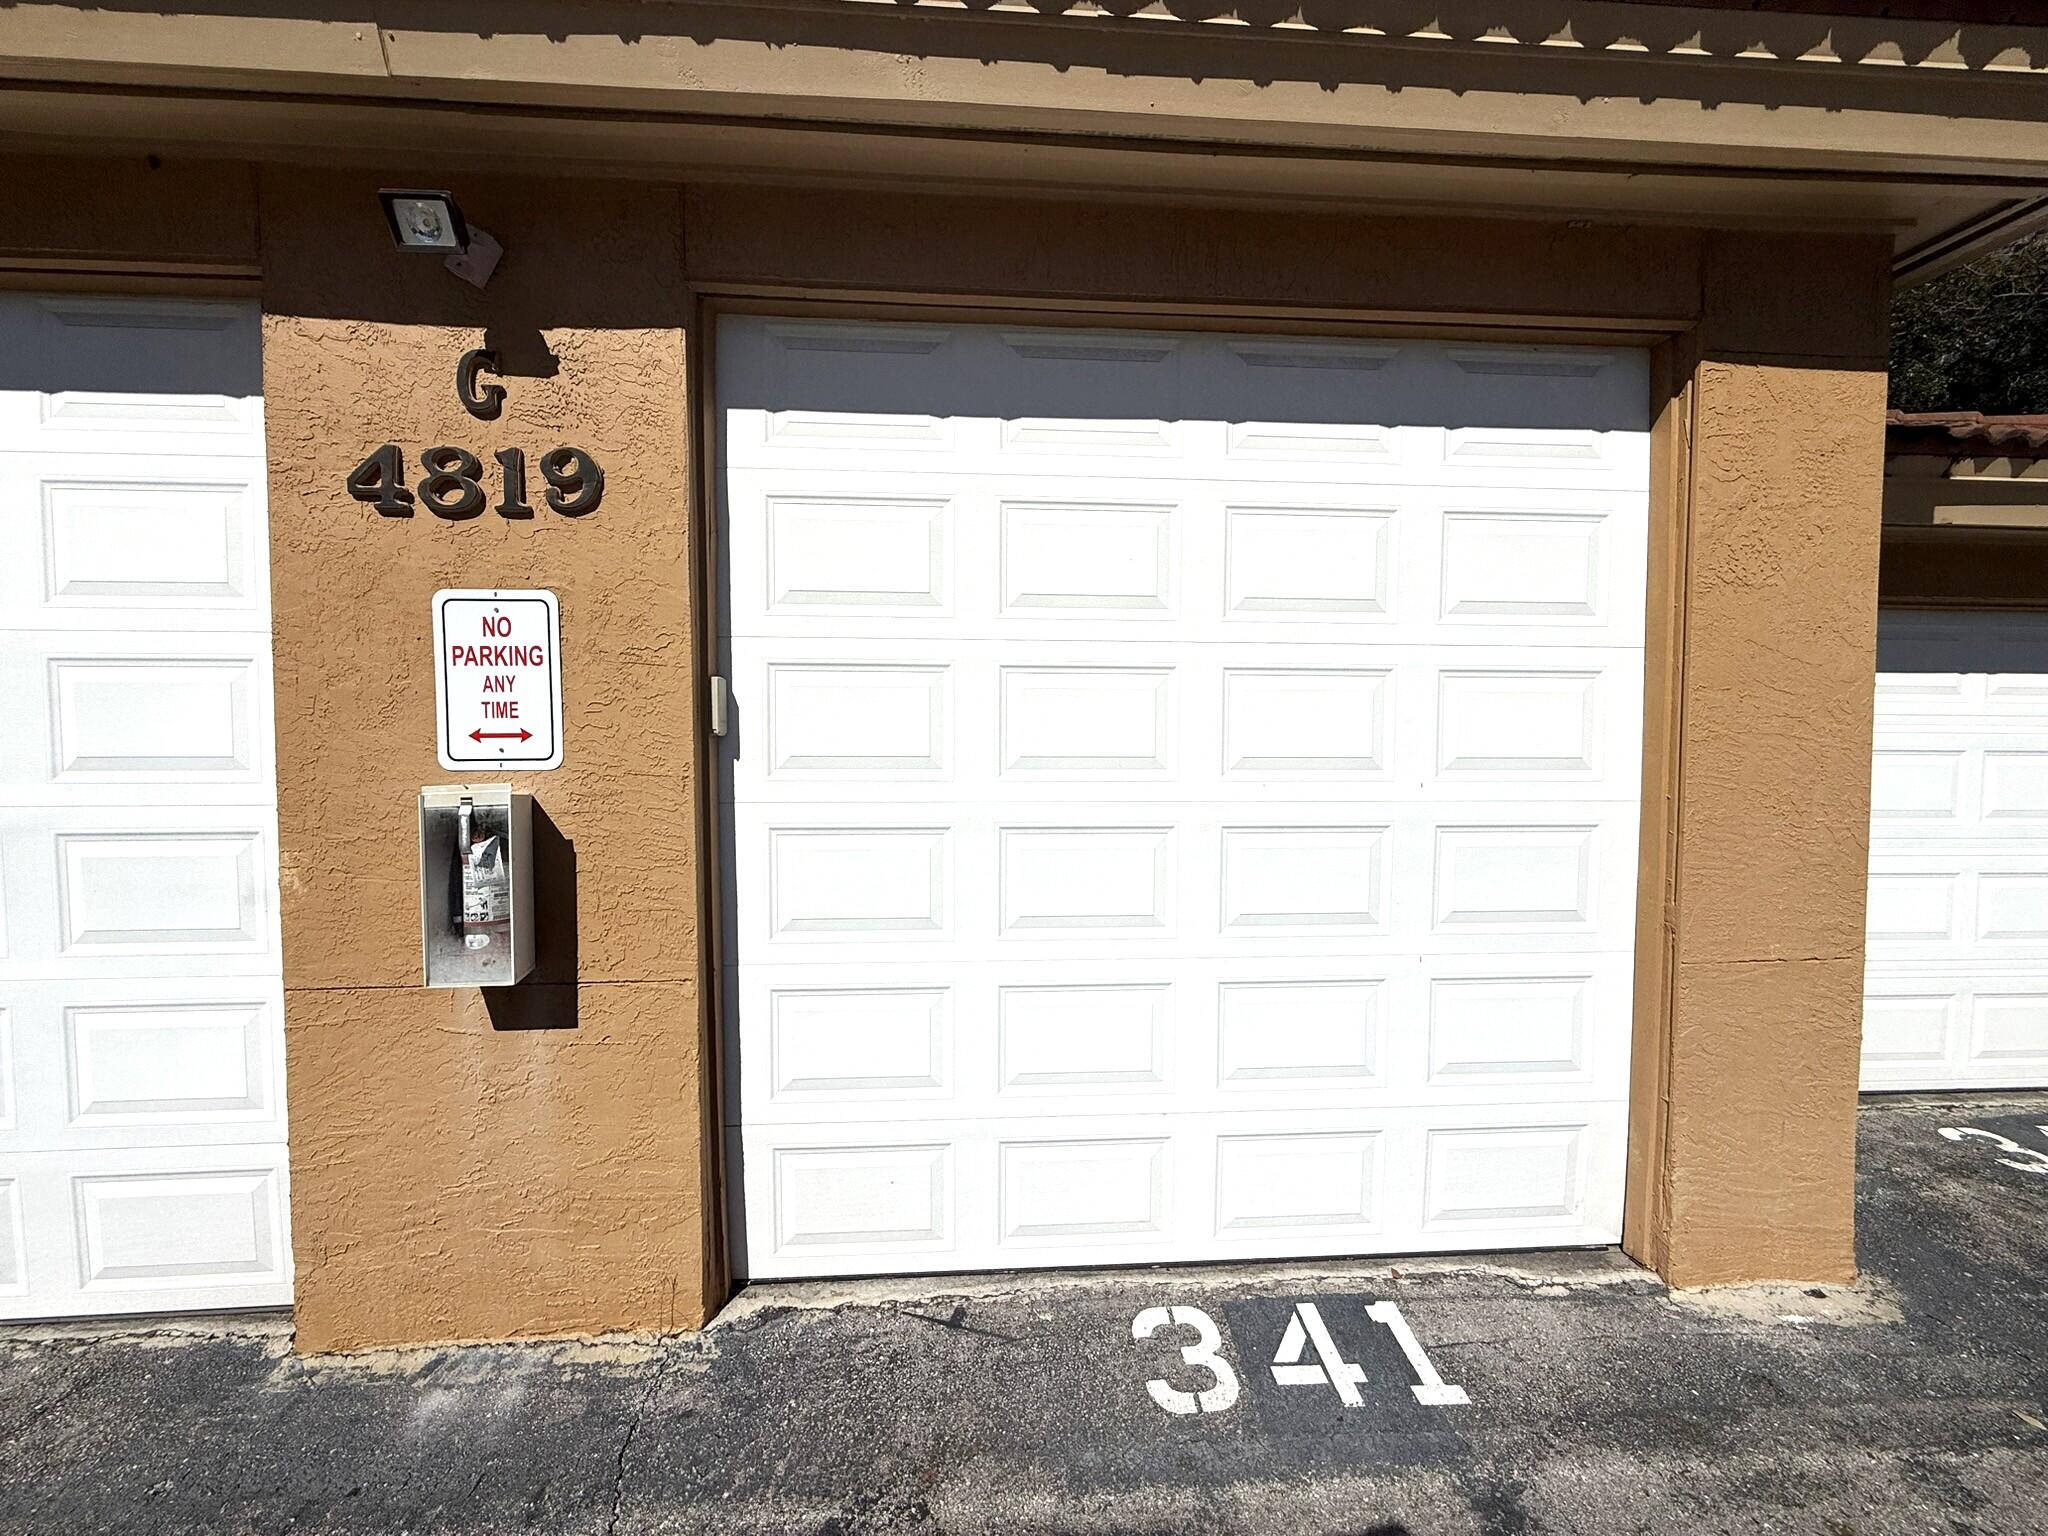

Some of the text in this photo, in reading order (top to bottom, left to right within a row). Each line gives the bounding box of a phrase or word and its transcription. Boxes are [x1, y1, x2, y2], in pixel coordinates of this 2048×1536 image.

[457, 349, 507, 420] G
[346, 444, 604, 520] 4819
[482, 616, 512, 637] NO
[452, 645, 544, 667] PARKING
[482, 675, 516, 693] ANY
[481, 701, 519, 719] TIME
[1938, 1127, 2048, 1175] 3
[1131, 1300, 1473, 1415] 341
